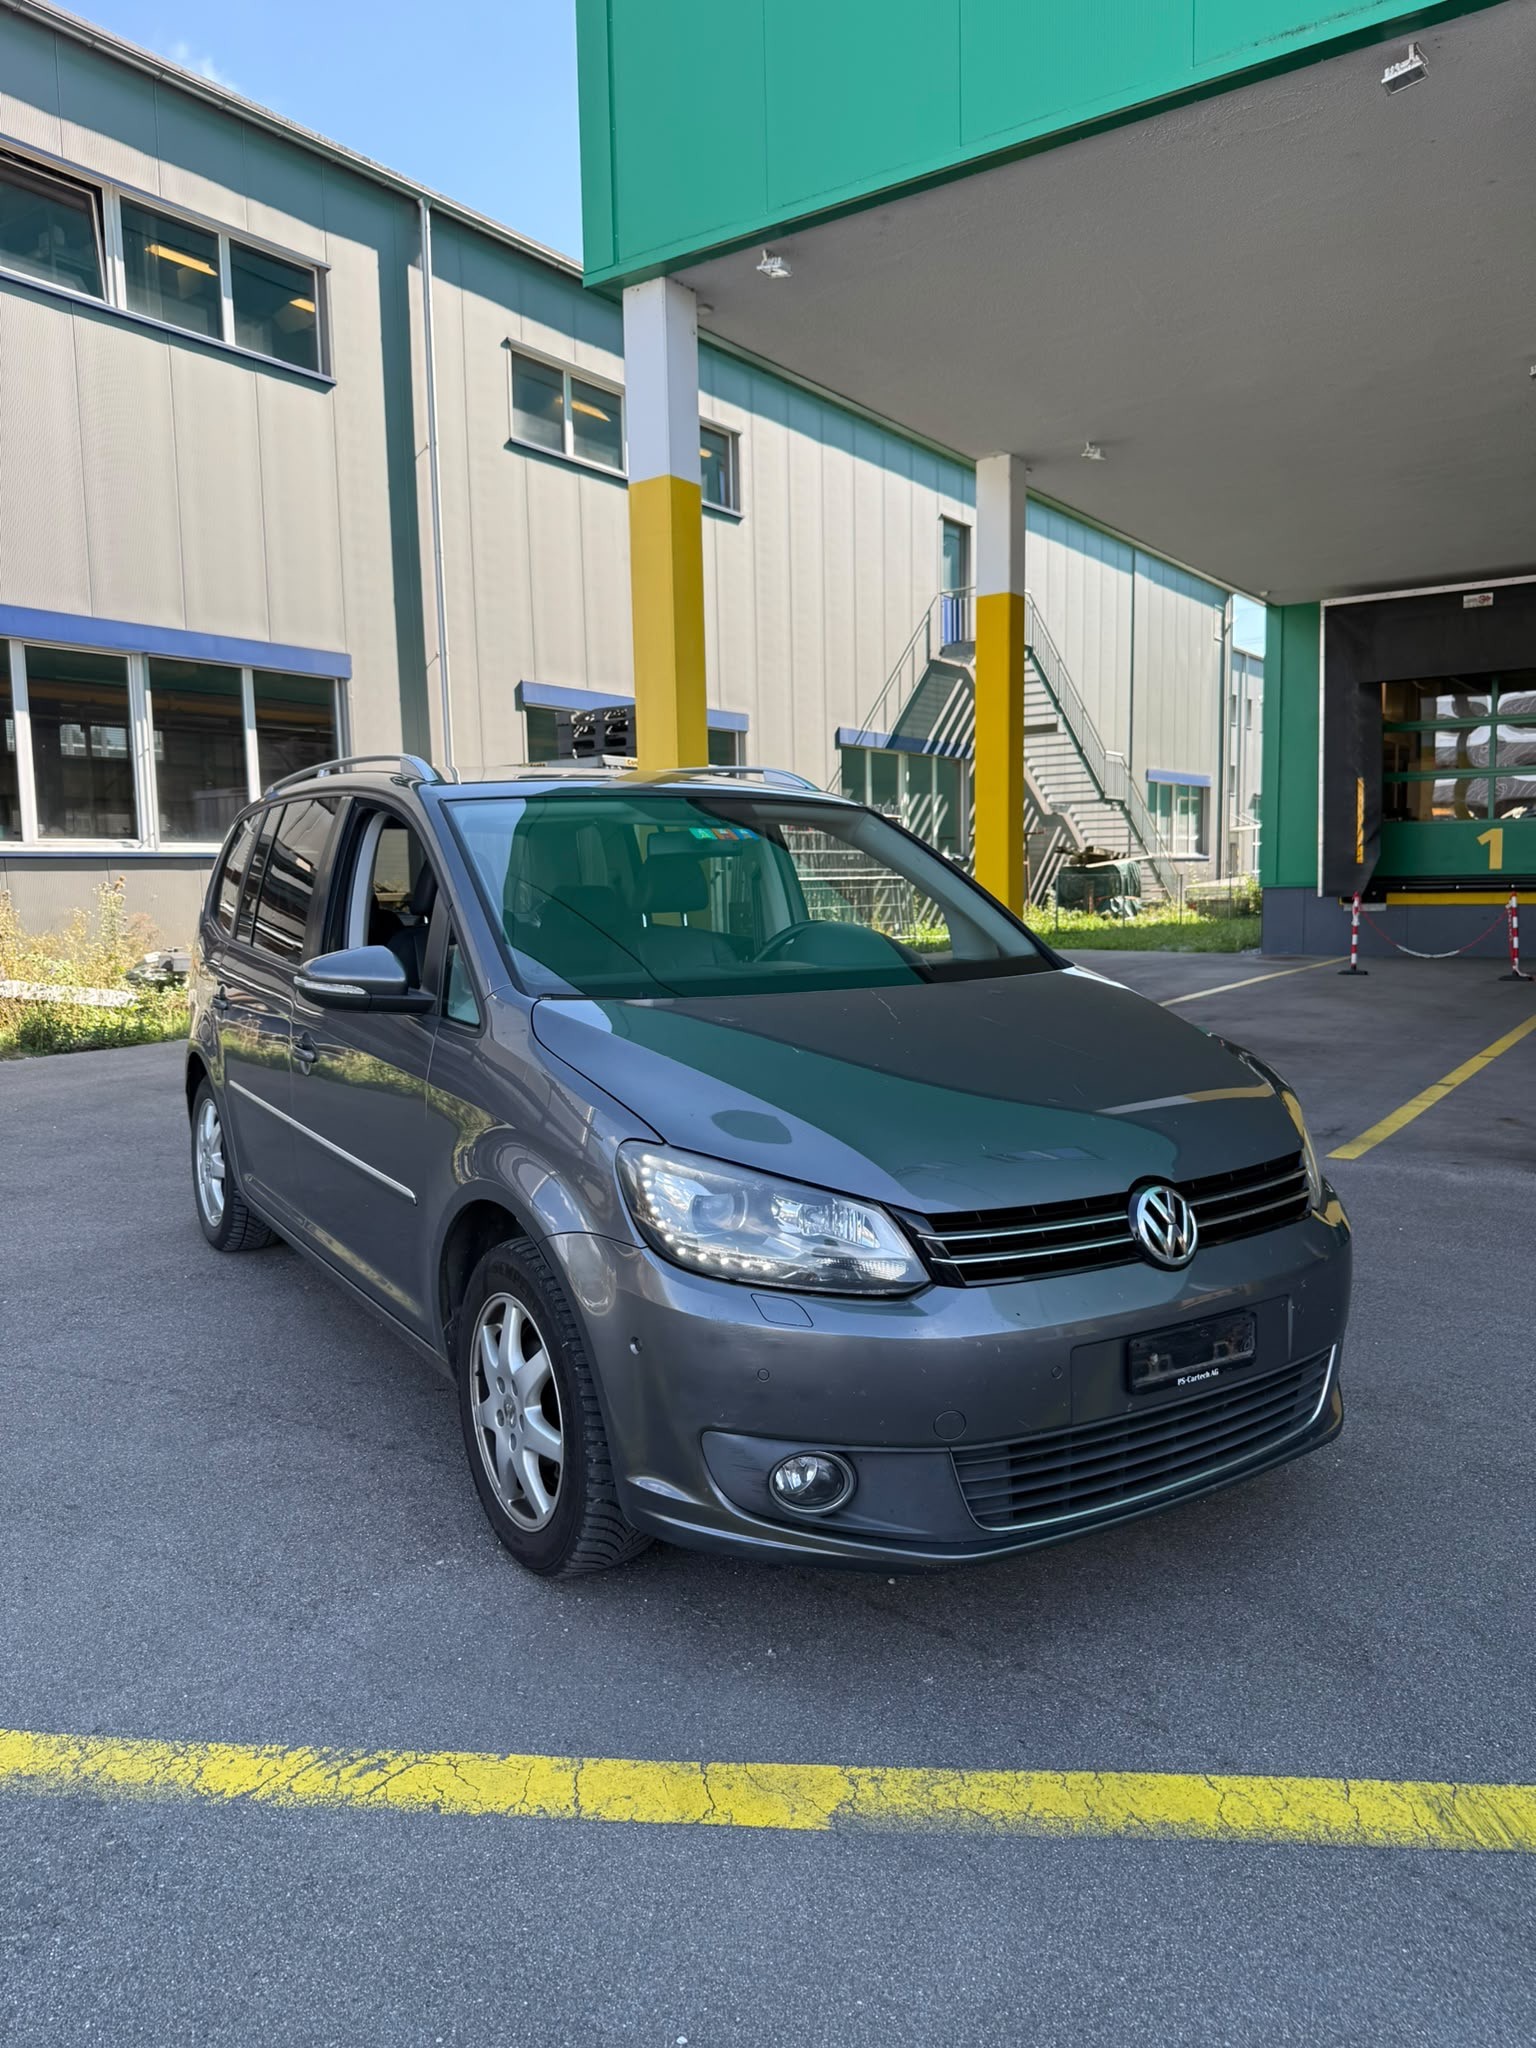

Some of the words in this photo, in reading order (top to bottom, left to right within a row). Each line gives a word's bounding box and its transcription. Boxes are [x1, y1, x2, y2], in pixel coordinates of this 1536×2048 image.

[1477, 828, 1503, 870] 1
[1137, 1186, 1194, 1265] VW
[1177, 1371, 1210, 1386] PS-Cartech
[1210, 1367, 1219, 1377] AG
